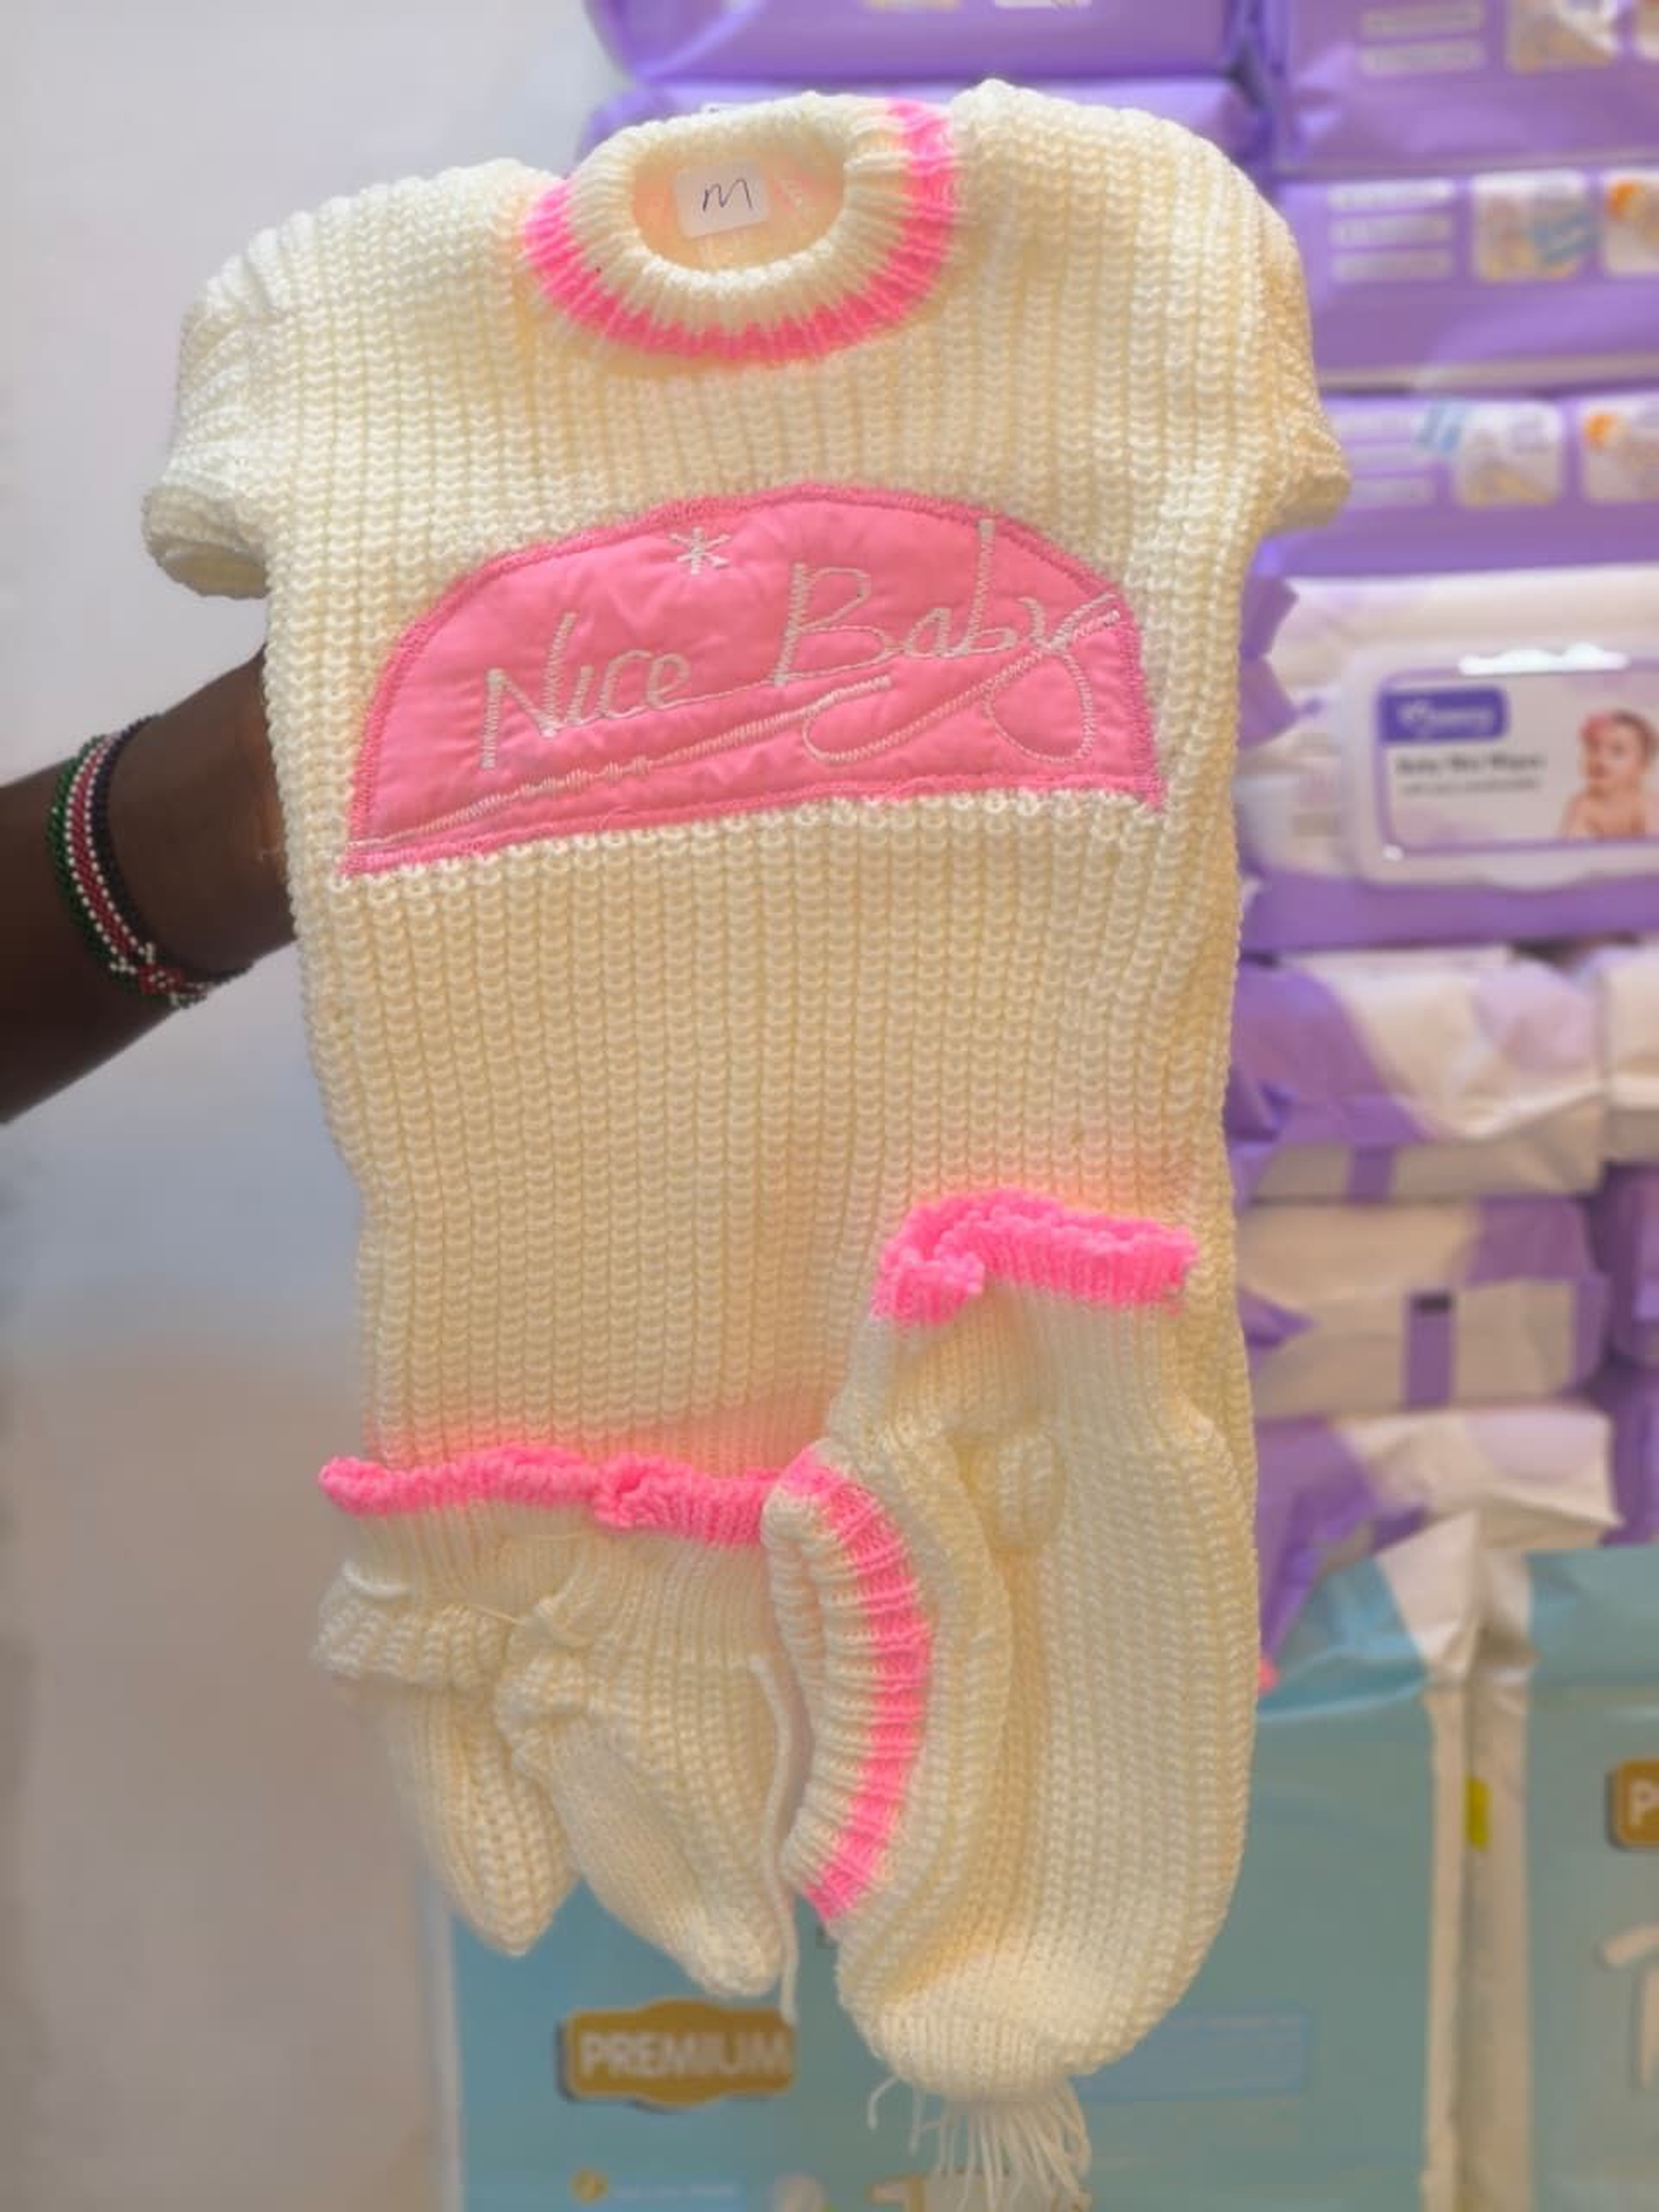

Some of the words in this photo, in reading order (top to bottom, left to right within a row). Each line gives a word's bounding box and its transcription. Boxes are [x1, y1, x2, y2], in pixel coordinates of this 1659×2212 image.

[481, 611, 691, 769] Nice
[774, 518, 1120, 765] Baby
[579, 2030, 788, 2079] PREMIUM
